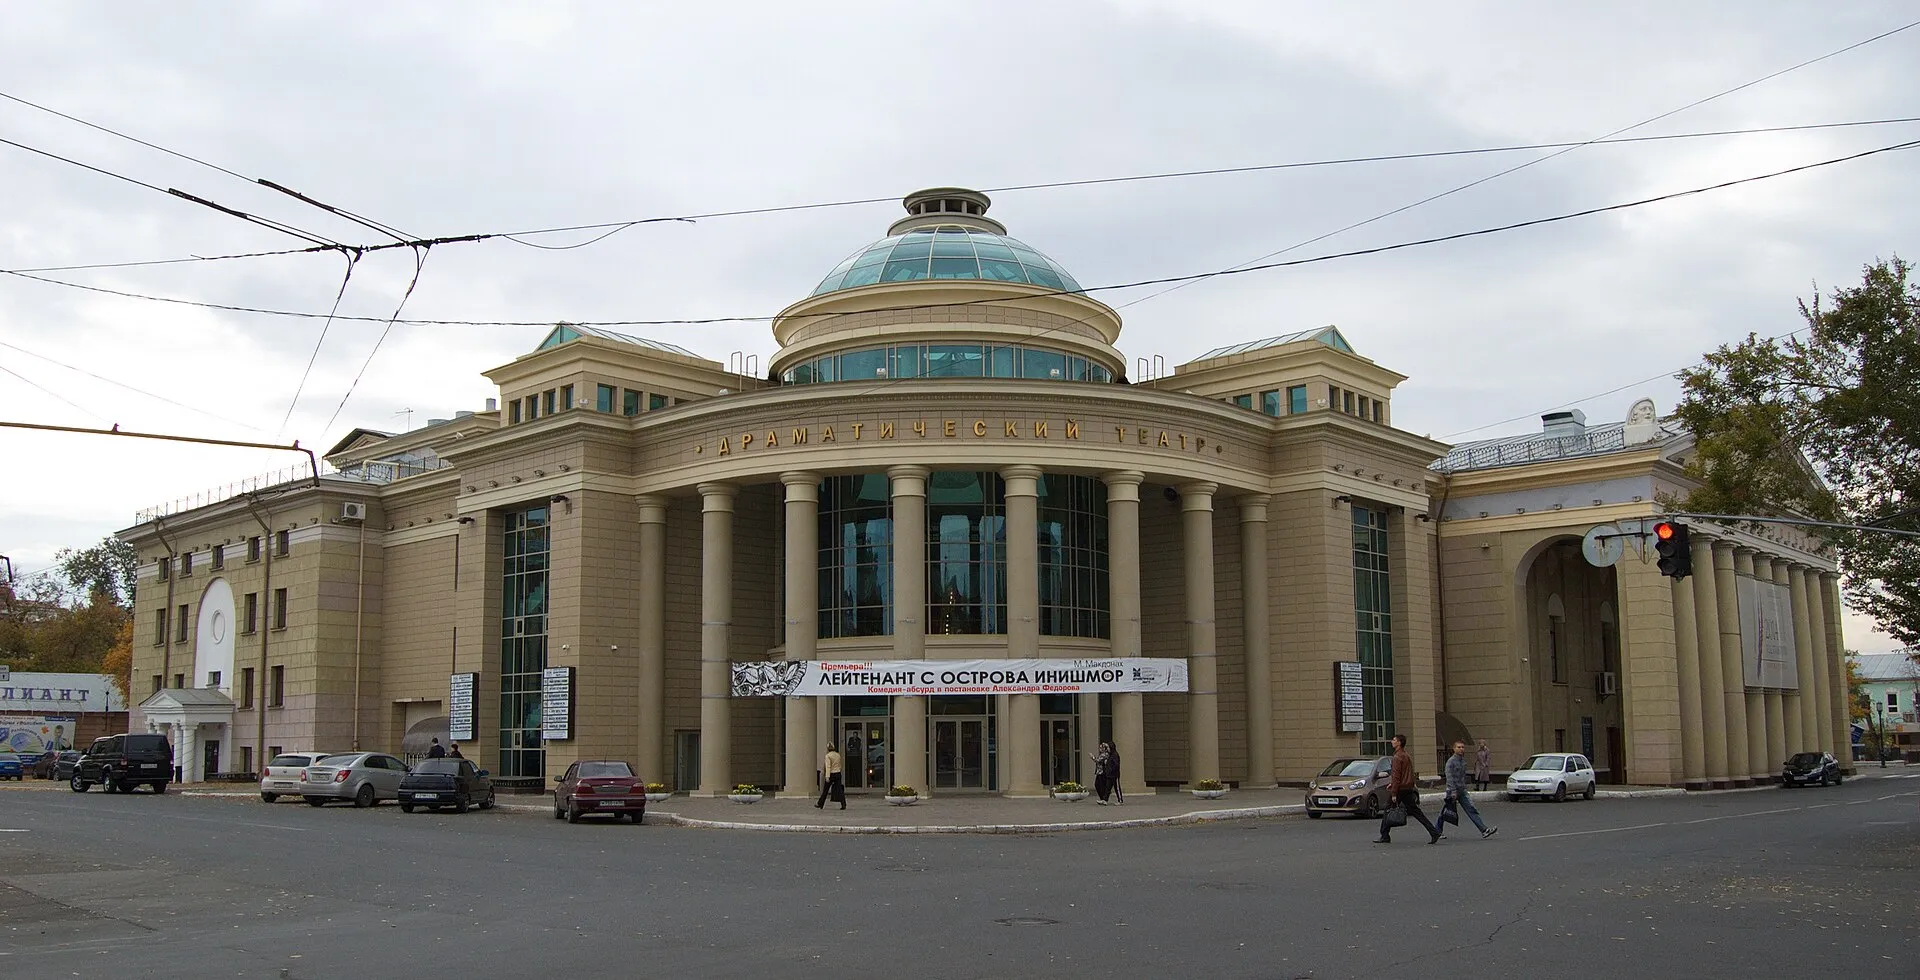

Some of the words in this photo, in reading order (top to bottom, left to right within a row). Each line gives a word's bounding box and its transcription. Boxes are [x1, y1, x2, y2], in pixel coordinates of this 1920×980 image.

[717, 418, 1080, 456] ДРАМАТИЧЕСКИЙ
[1115, 425, 1208, 453] ТЕАТР
[820, 662, 873, 671] Премьера!!!
[1073, 660, 1084, 668] М.
[1085, 660, 1124, 669] Макдонах
[819, 671, 915, 685] ЛЕЙТЕНАНТ
[920, 671, 935, 685] С
[940, 671, 1029, 685] ОСТРОВА
[1034, 669, 1124, 684] ИНИШМОР
[992, 685, 1040, 693] Александра
[1042, 684, 1080, 692] Федорова
